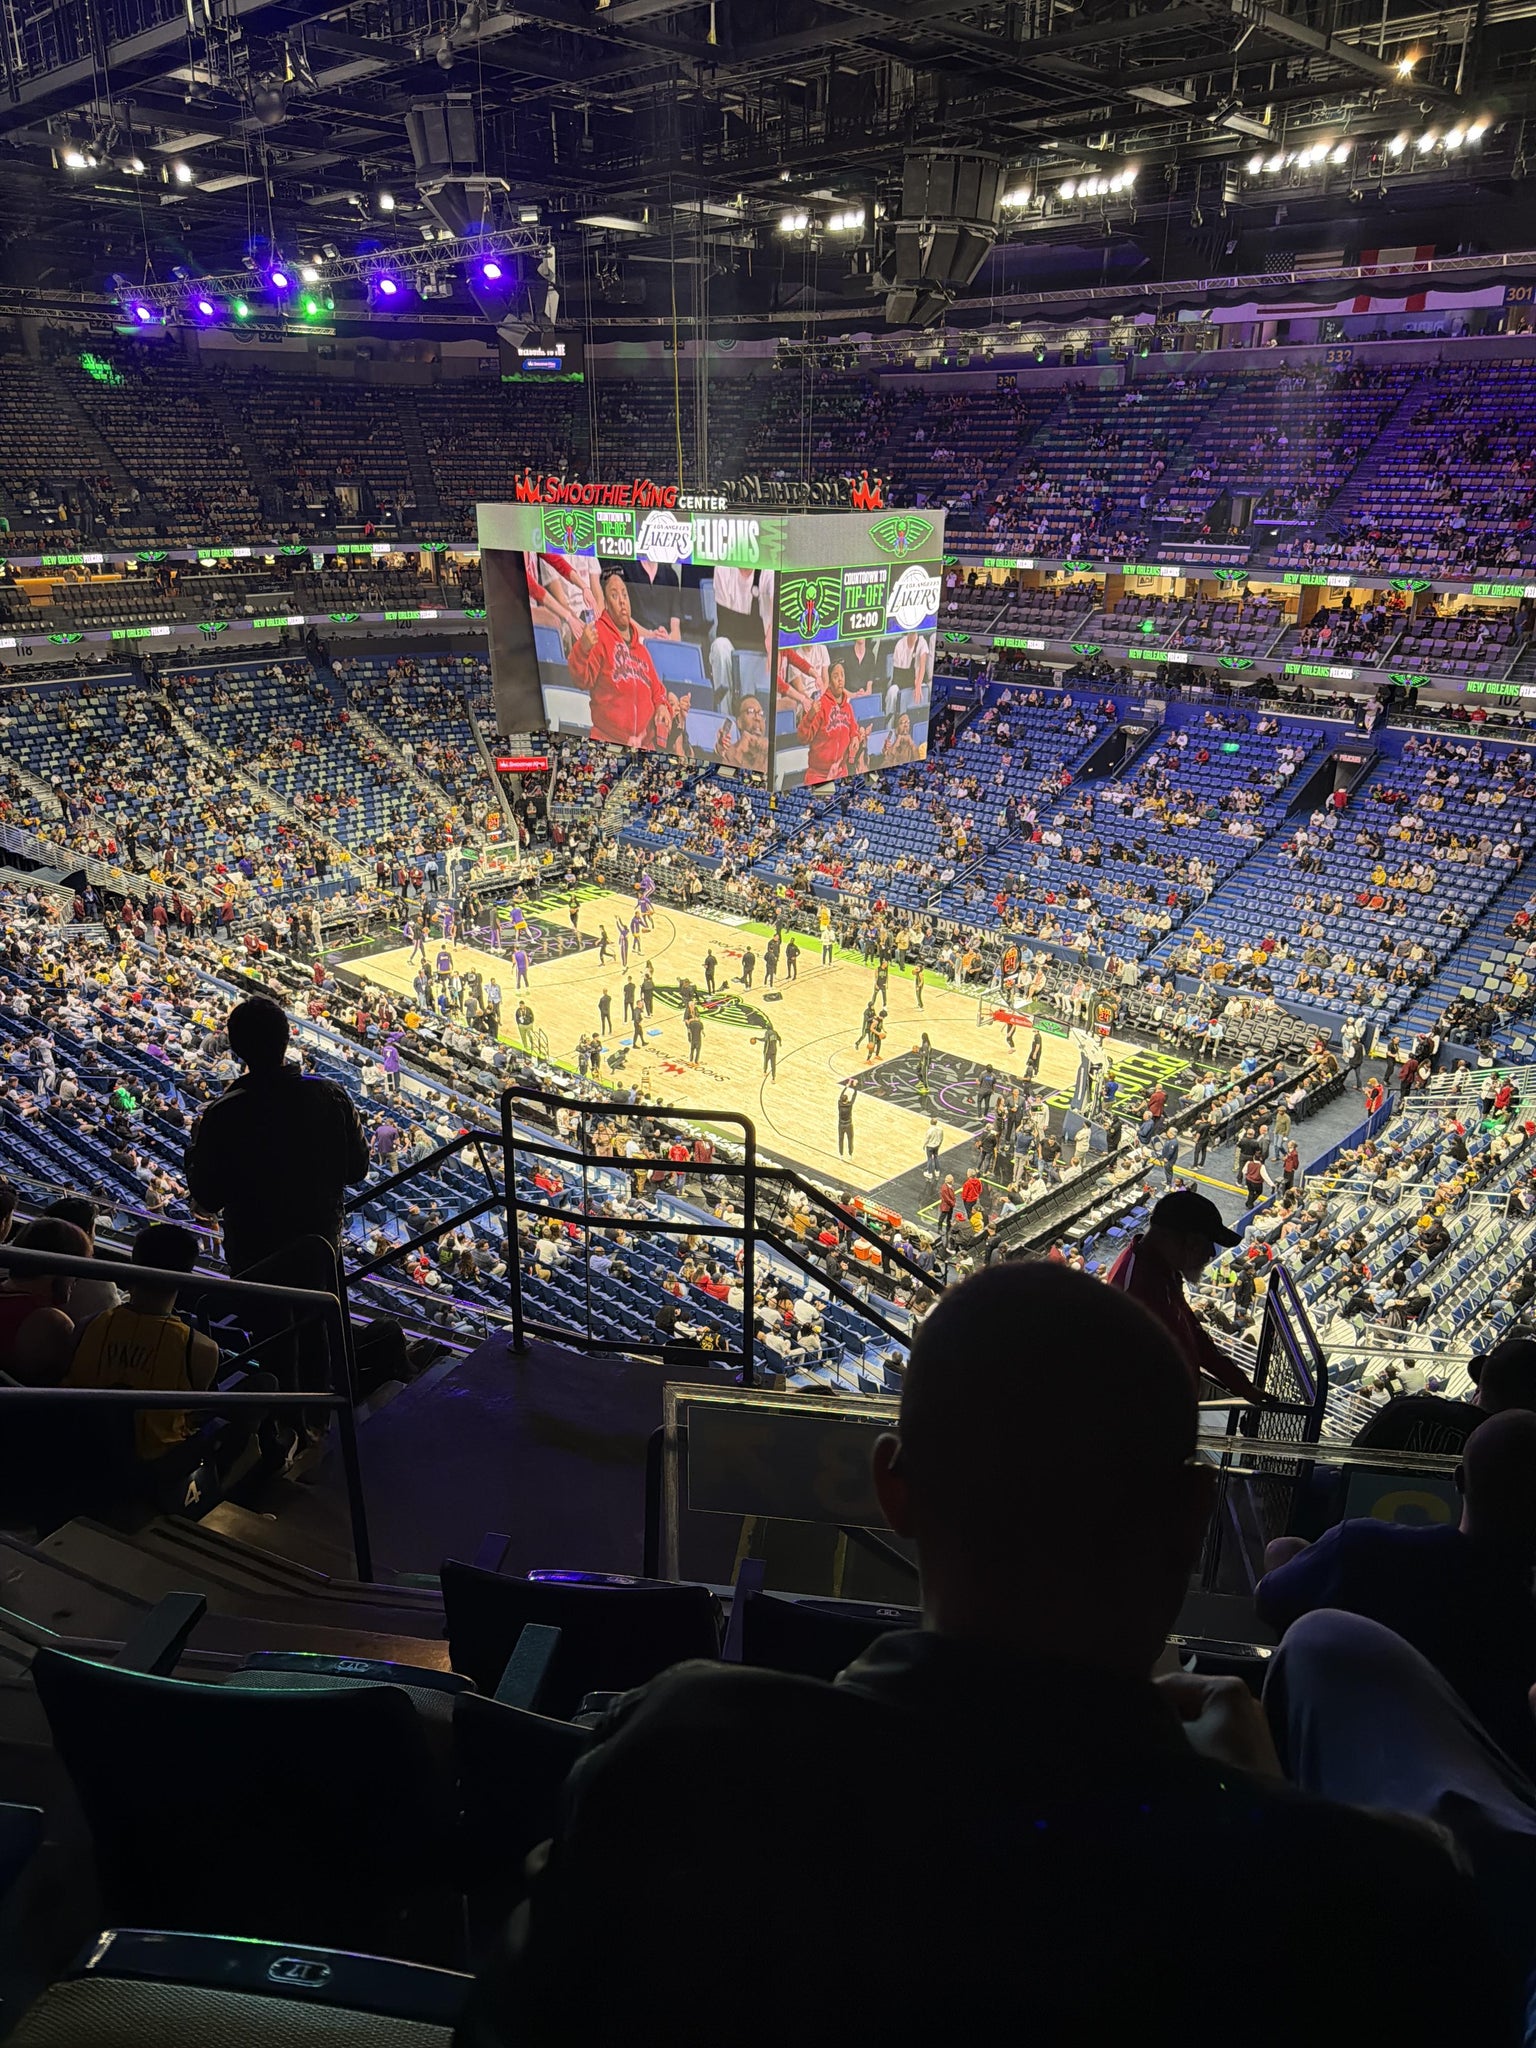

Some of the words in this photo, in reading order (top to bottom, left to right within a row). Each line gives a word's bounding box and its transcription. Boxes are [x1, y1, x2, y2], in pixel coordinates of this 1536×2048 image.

[1506, 287, 1532, 301] 301
[1326, 350, 1351, 363] 332
[997, 375, 1016, 387] 330
[544, 476, 631, 504] SMOOTHIE
[679, 496, 728, 510] CENTER
[601, 522, 627, 536] TIP-OFF
[599, 537, 633, 555] 12:00
[640, 524, 690, 555] LAKERS
[844, 570, 878, 586] COUNTDOWN
[878, 569, 888, 582] TO
[1284, 573, 1300, 584] NEW
[1299, 574, 1327, 586] ORLEANS
[844, 584, 885, 609] TIP-OFF
[1472, 583, 1491, 595] NEW
[1491, 584, 1524, 597] ORLEANS
[889, 584, 939, 614] LAKERS
[849, 611, 879, 629] 12:00
[16, 646, 32, 656] 118
[1285, 663, 1301, 674] NEW
[1301, 664, 1330, 677] ORLEANS
[1466, 681, 1486, 692] NEW
[1485, 682, 1520, 697] ORLEANS
[1498, 695, 1522, 707] 102
[1004, 957, 1016, 972] 24
